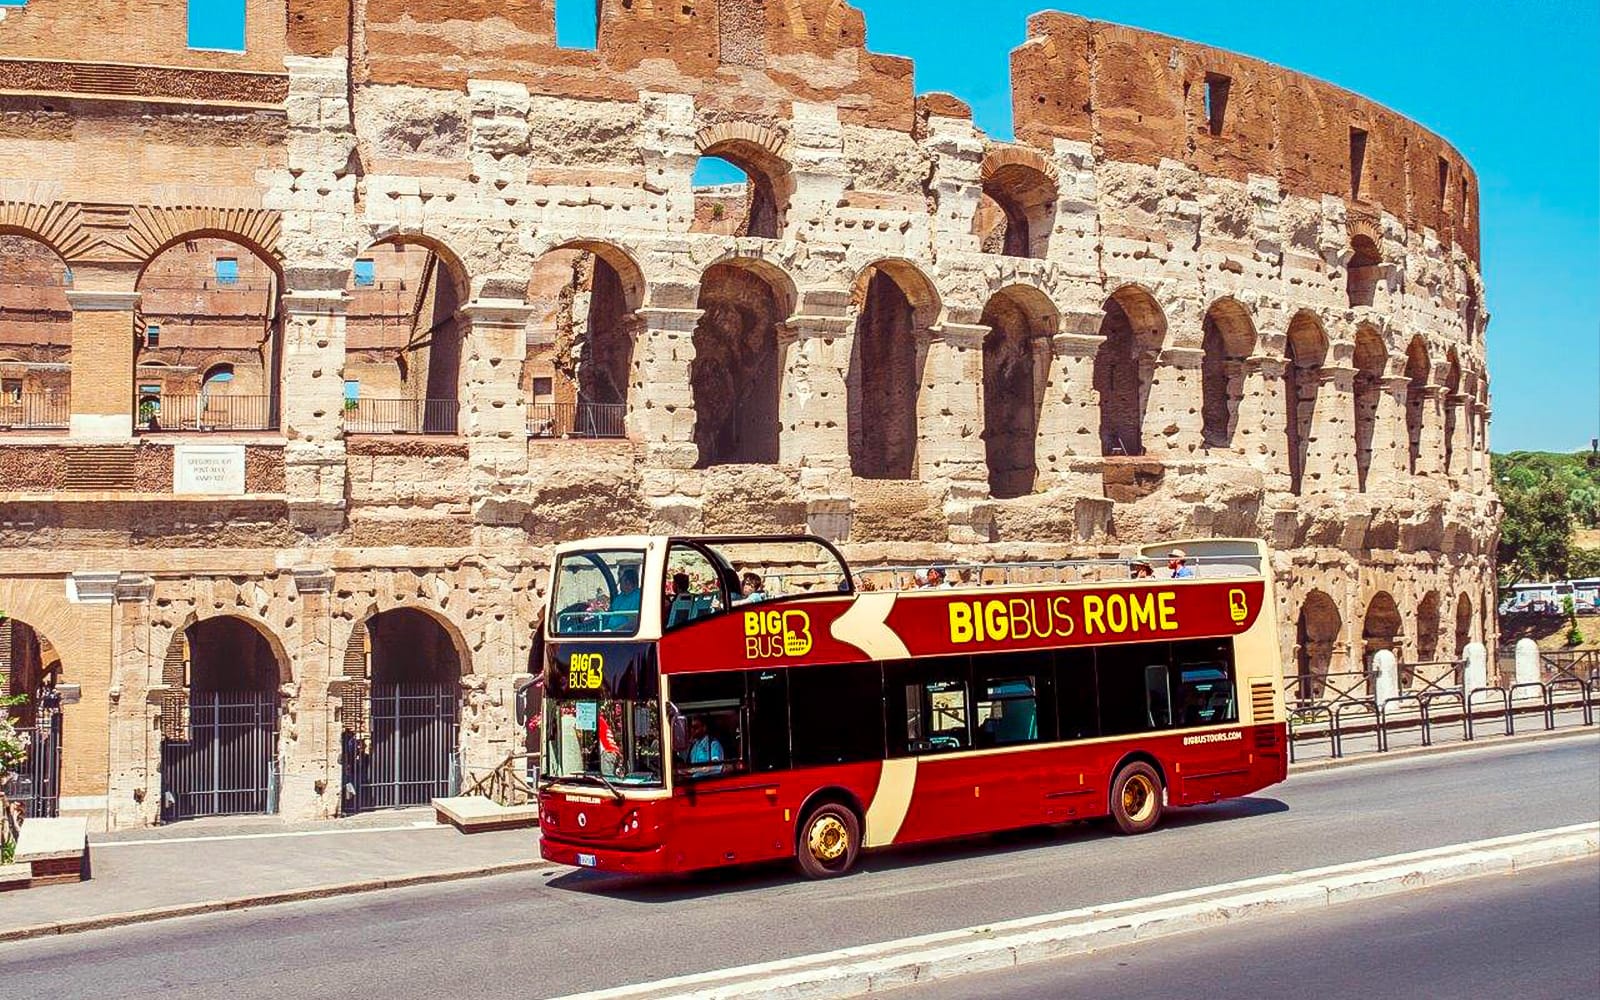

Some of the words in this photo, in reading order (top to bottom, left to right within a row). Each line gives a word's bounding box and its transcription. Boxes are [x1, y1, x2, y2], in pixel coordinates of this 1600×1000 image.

[744, 610, 782, 636] BIG
[949, 598, 1074, 643] BIGBUS
[1083, 592, 1179, 634] ROME
[746, 635, 784, 659] BUS
[570, 653, 589, 672] BIG
[569, 672, 588, 689] BUS
[1183, 731, 1242, 746] BIGBUSTOURS.COM
